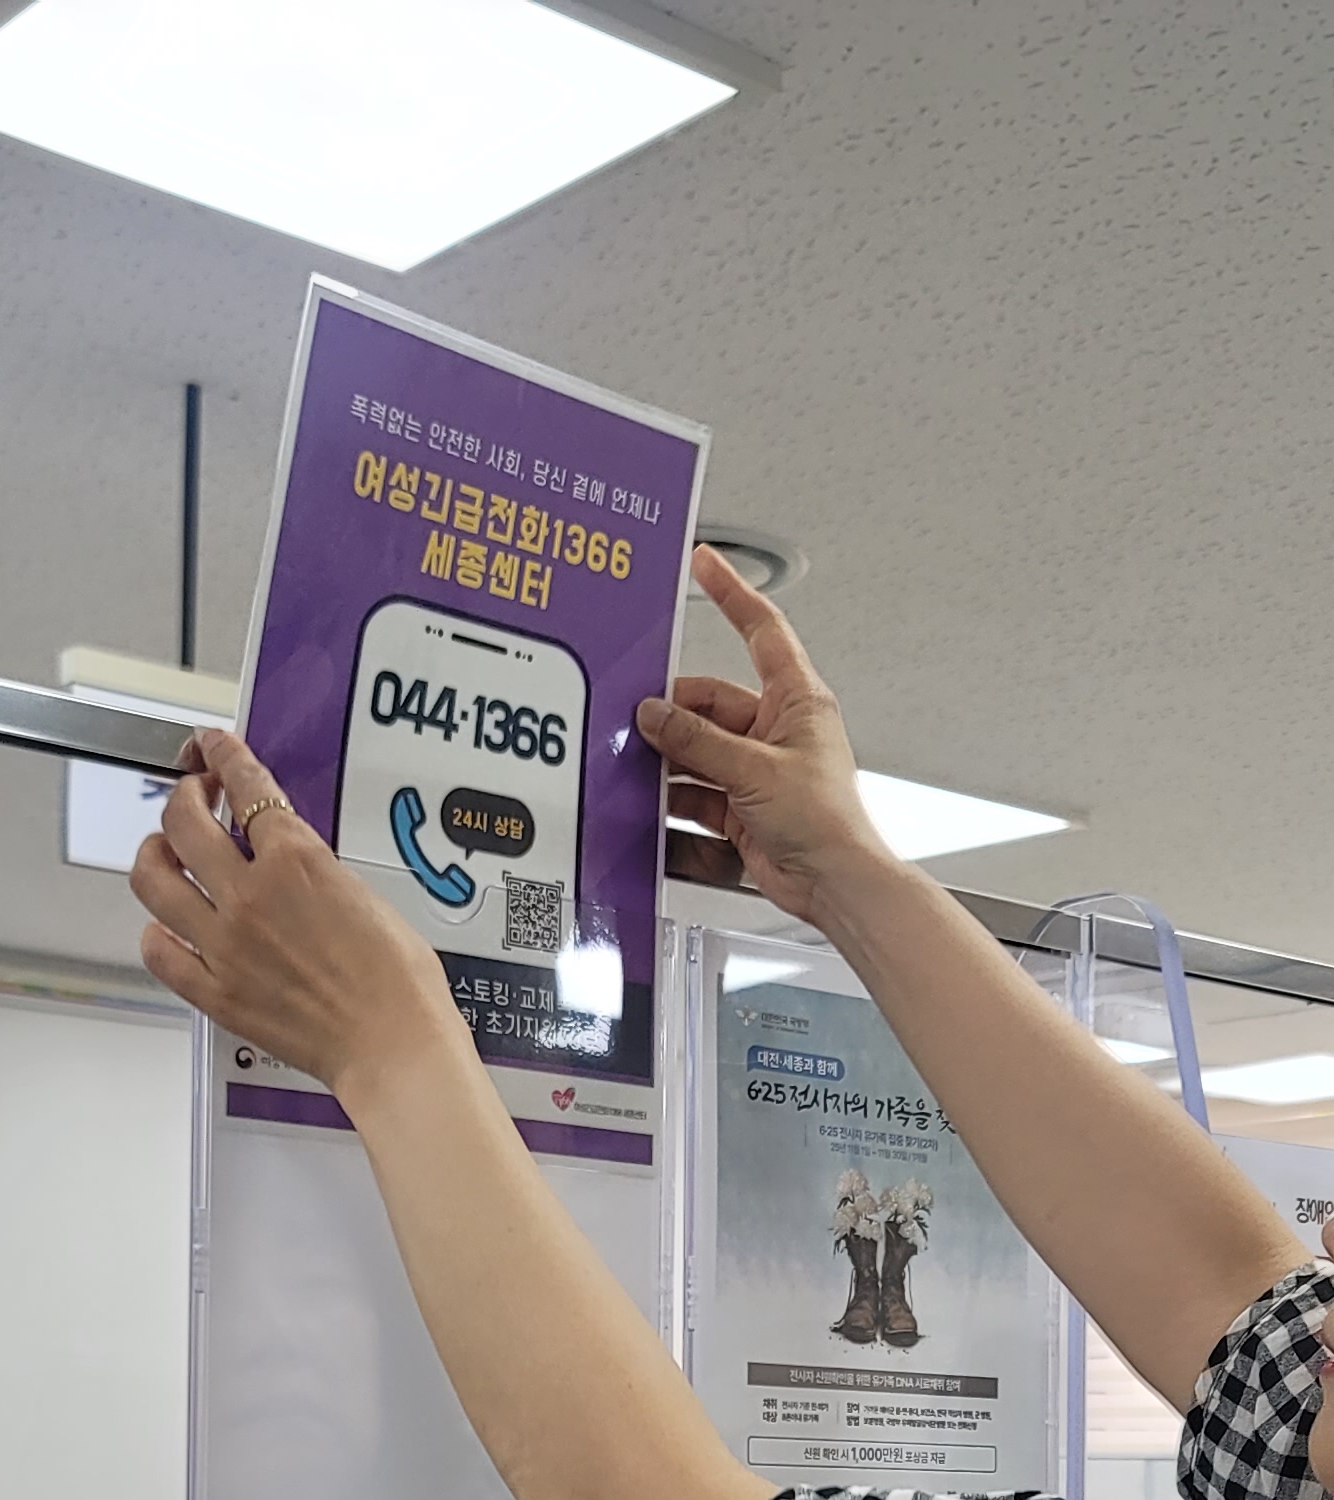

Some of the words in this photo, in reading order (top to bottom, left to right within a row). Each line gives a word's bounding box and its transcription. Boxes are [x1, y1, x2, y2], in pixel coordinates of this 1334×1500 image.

[350, 394, 422, 444] 폭력없는
[429, 420, 481, 463] 안전한
[486, 444, 526, 481] 사회,
[533, 459, 567, 494] 당신
[573, 470, 605, 506] 곁에
[611, 487, 661, 525] 언제나
[353, 450, 633, 581] 여성긴급전화1366
[421, 530, 553, 611] 세종센터
[371, 670, 569, 766] 044·1366
[452, 807, 489, 832] 24시
[493, 814, 525, 840] 상담
[817, 1060, 838, 1078] 함께
[789, 1084, 868, 1118] 전사자의
[875, 1096, 932, 1130] 가족을
[803, 1448, 820, 1461] 신원
[822, 1448, 839, 1461] 확인
[840, 1449, 849, 1461] 시
[851, 1447, 903, 1464] 1,000만원
